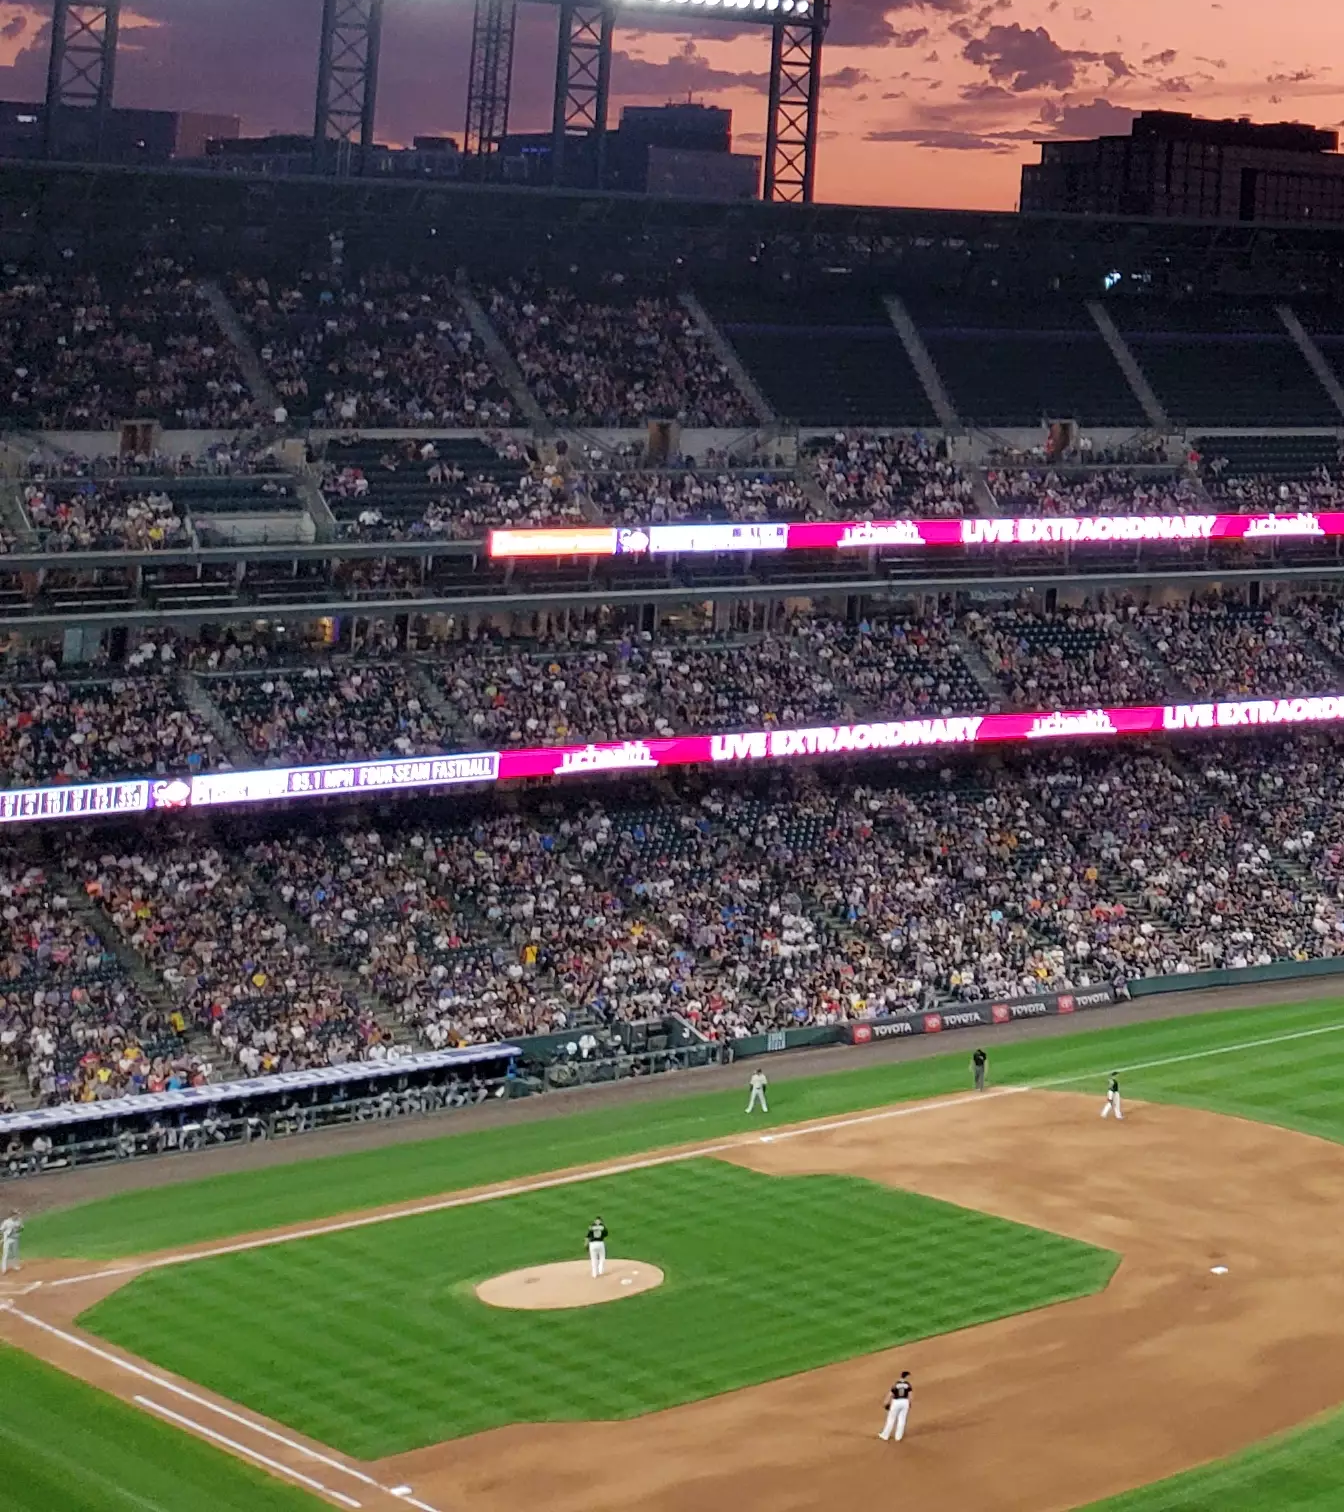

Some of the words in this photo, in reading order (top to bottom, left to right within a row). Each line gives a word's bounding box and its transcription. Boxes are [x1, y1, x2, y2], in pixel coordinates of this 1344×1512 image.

[844, 520, 920, 542] uchealth
[963, 519, 1017, 543] LIVE
[1019, 516, 1216, 542] EXTRAORDINARY
[1249, 513, 1319, 534] uchealth
[432, 757, 491, 779] FASTBALL
[563, 740, 652, 770] uchealth
[711, 734, 767, 761] LIVE
[770, 716, 983, 758] EXTRAORDINARY
[1033, 710, 1112, 733] uchealth
[1163, 703, 1214, 729] LIVE
[1076, 992, 1110, 1006] TOYOTA
[1011, 1002, 1047, 1016] TOYOTA
[944, 1012, 981, 1026] TOYOTA
[872, 1022, 912, 1037] TOYOTA
